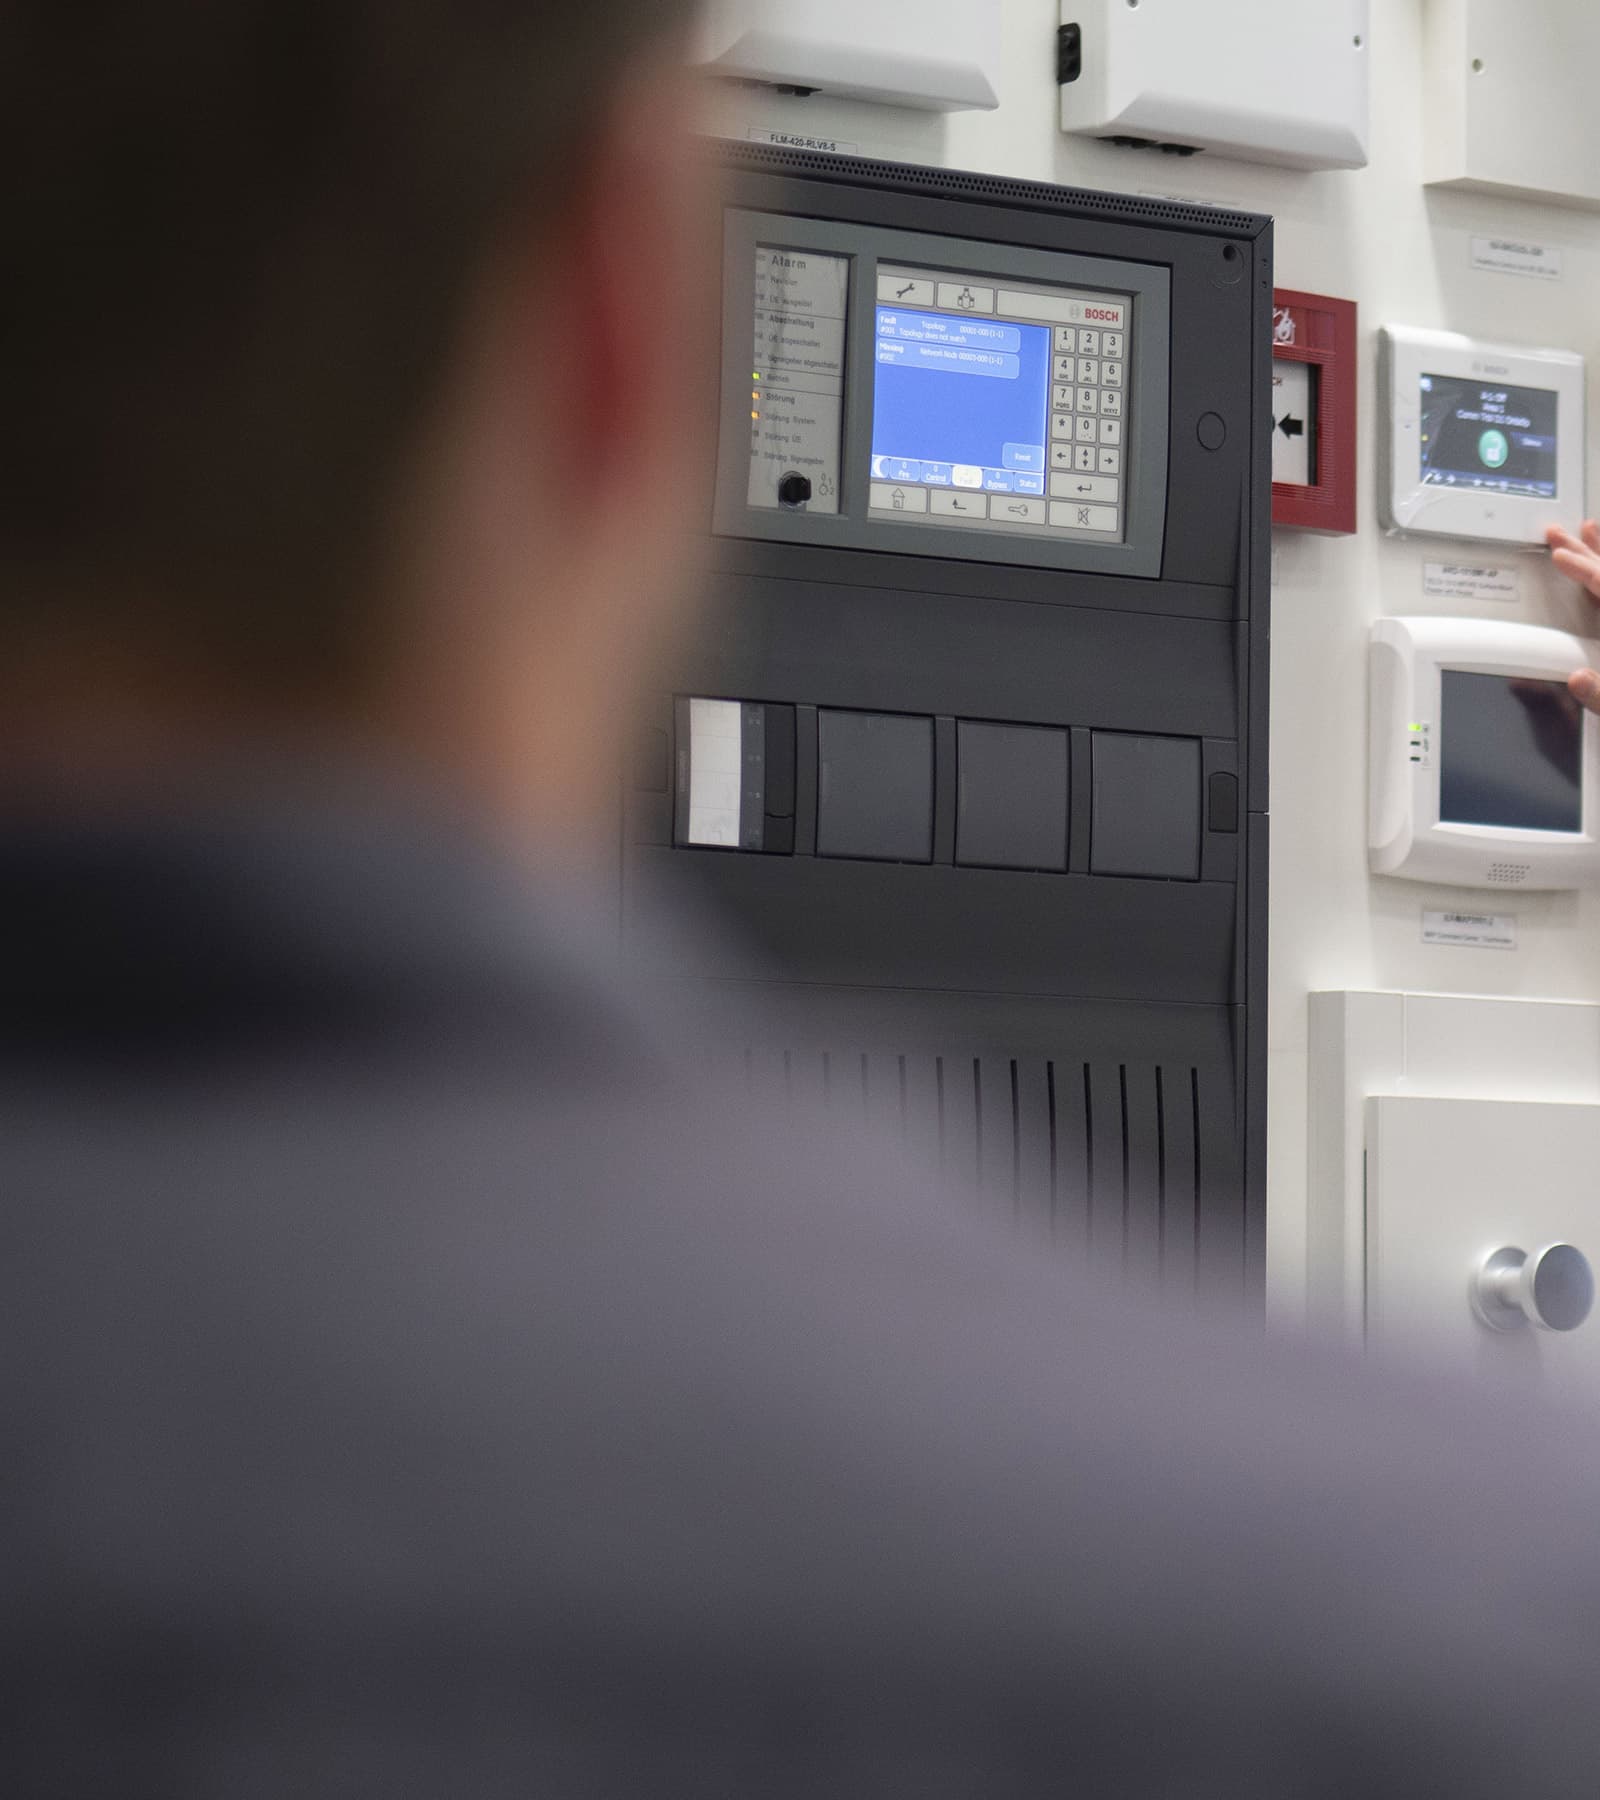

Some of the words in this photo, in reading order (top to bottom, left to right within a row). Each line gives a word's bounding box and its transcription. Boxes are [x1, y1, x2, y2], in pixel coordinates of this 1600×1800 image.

[772, 255, 806, 269] Alarm
[1085, 308, 1119, 322] BOSCH
[1063, 330, 1068, 341] 1
[1086, 333, 1092, 344] 2
[1110, 336, 1116, 346] 3
[1061, 359, 1067, 369] 4
[1085, 362, 1091, 372] 5
[1108, 364, 1115, 375] 6
[766, 392, 796, 405] Störung
[1060, 388, 1066, 399] 7
[1084, 391, 1090, 401] 8
[1108, 393, 1114, 404] 9
[1083, 420, 1090, 430] 0
